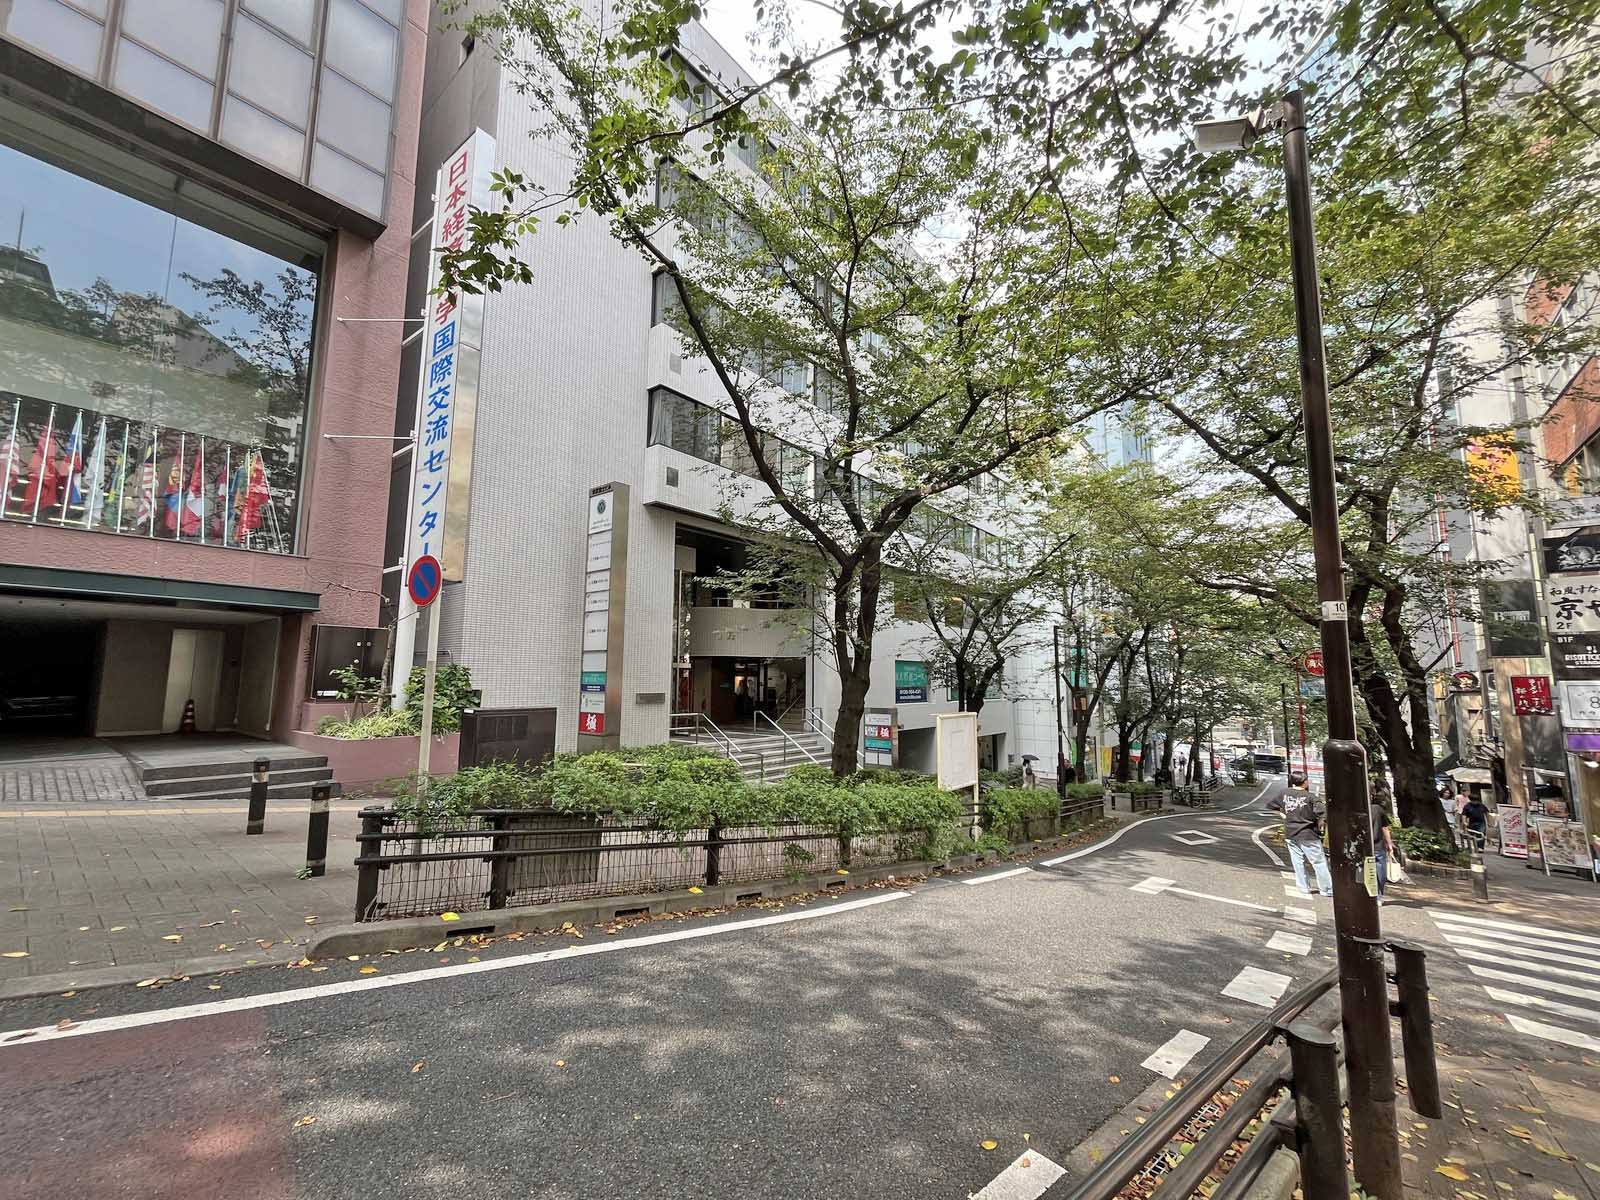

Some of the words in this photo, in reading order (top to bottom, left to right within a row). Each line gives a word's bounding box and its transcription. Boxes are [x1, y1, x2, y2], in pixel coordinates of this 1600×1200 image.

[418, 150, 468, 555] 日本経学国際交流センター
[1335, 602, 1346, 613] 10
[1556, 622, 1573, 630] 2F
